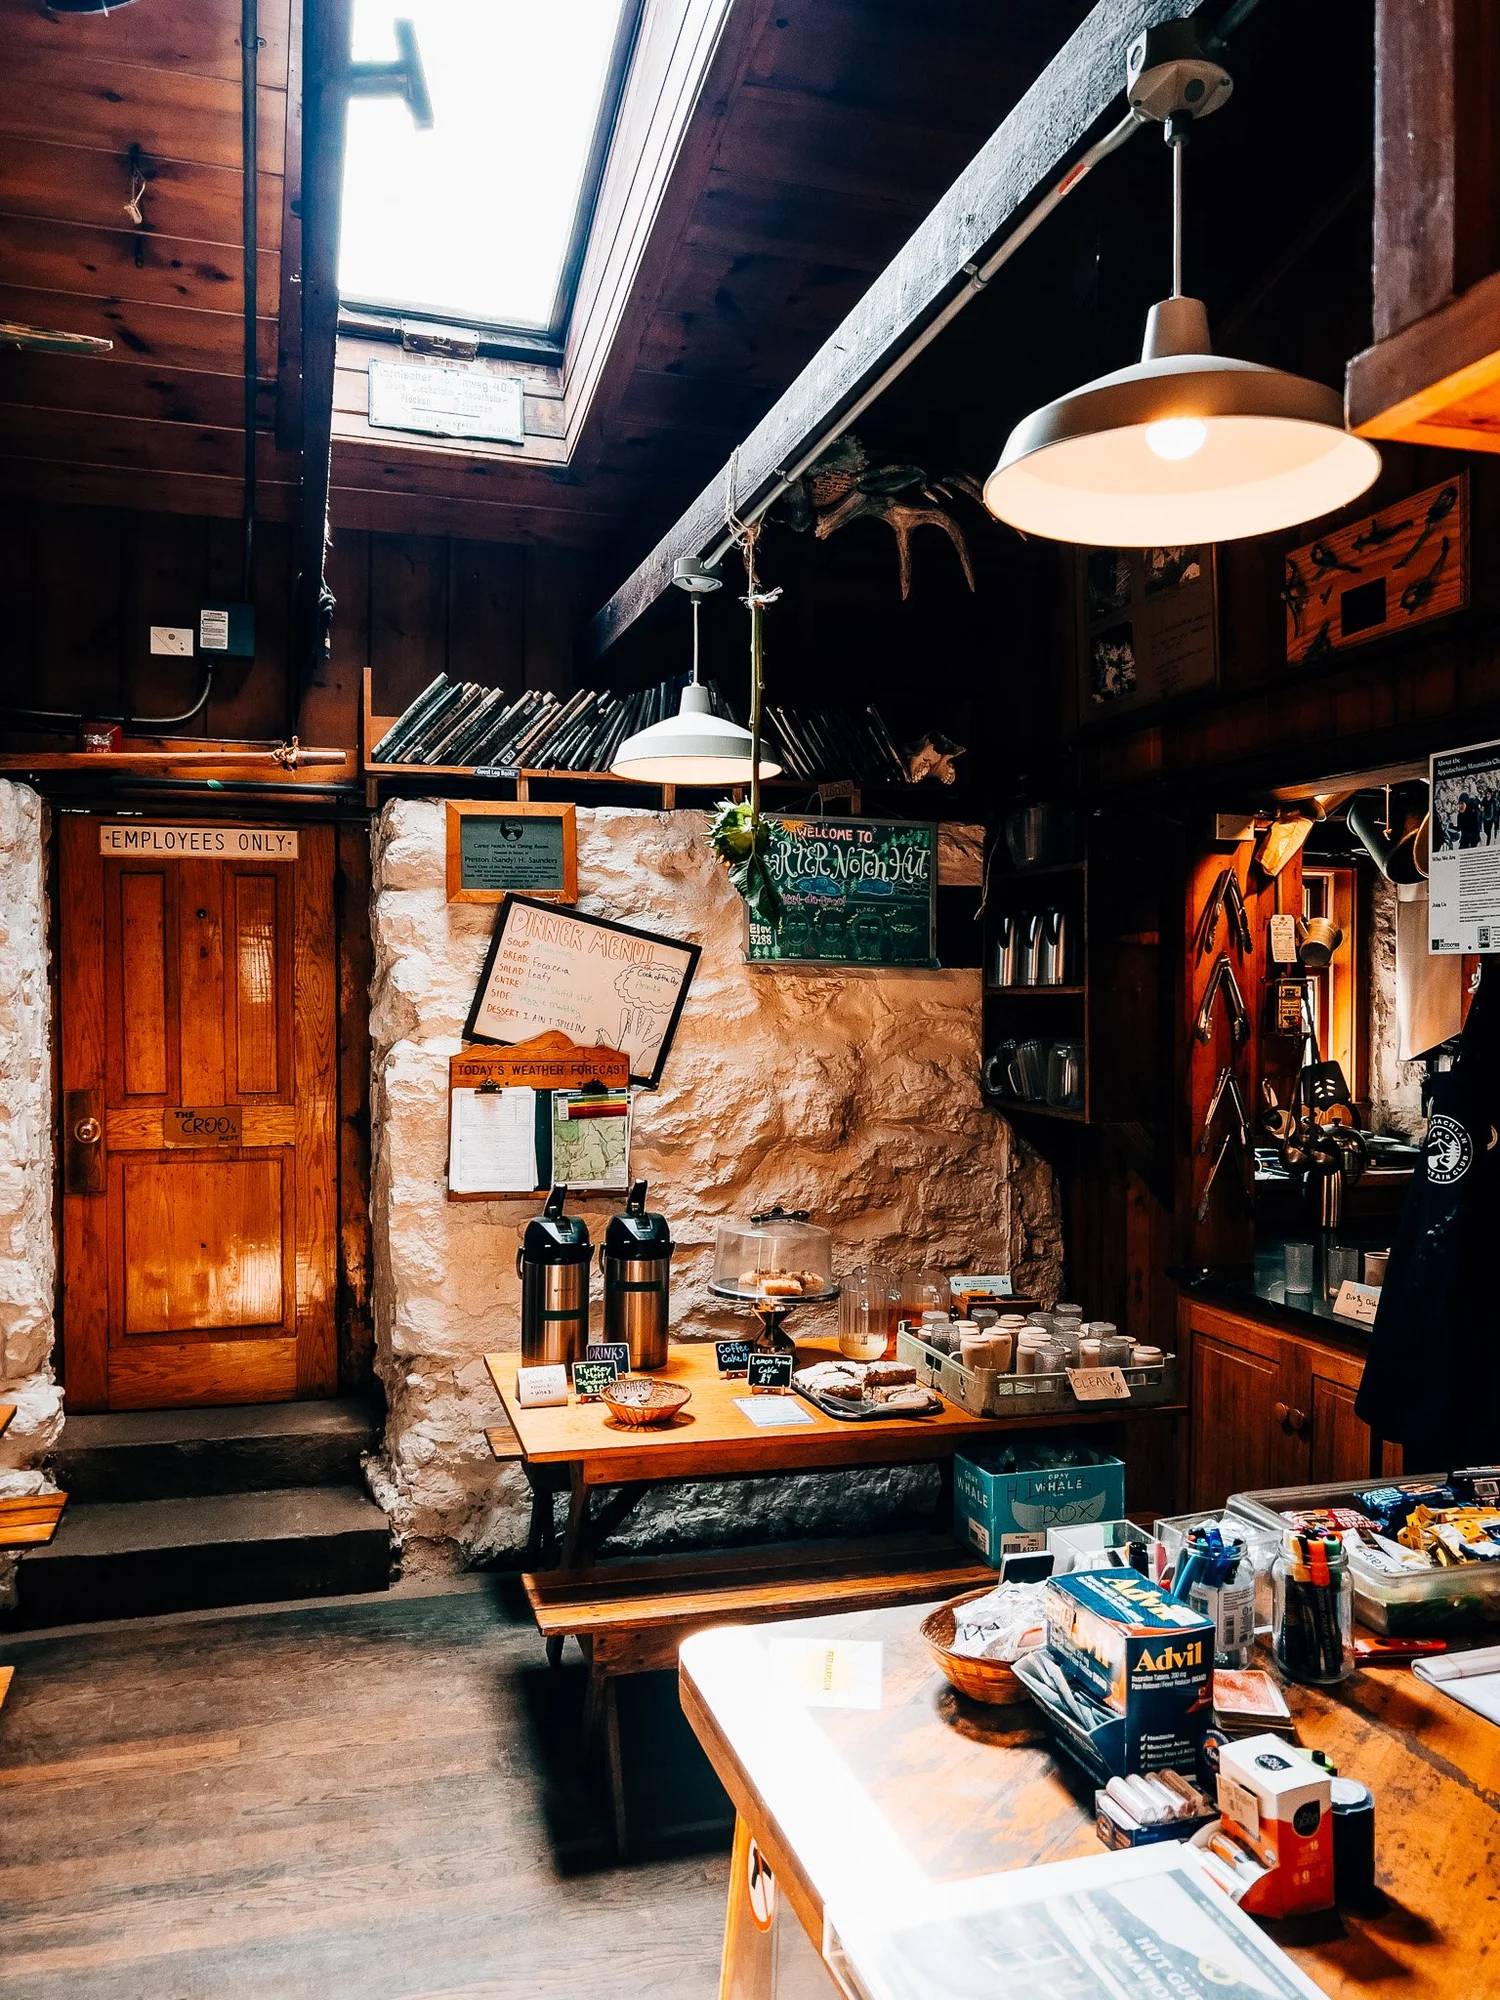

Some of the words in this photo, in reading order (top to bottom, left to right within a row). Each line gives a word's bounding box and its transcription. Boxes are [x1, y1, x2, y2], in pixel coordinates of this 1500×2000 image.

[86, 746, 109, 754] FIRE
[111, 830, 225, 851] EMPLOYEES
[238, 833, 286, 853] ONLY
[796, 826, 853, 842] WELCOME
[858, 829, 874, 845] TO
[465, 856, 490, 864] Preston
[492, 856, 517, 865] (Sandy)
[528, 857, 558, 865] Saunders
[511, 907, 585, 951] DINNER
[588, 931, 654, 964] MENU!
[750, 934, 772, 945] 3288
[502, 950, 530, 965] BREAD:
[458, 1064, 505, 1076] TODAY'S
[512, 1064, 564, 1076] WEATHER
[571, 1064, 627, 1076] FORECAST
[174, 1110, 195, 1119] THE
[218, 1134, 239, 1142] NEST
[1432, 1131, 1450, 1140] AMC
[1452, 1155, 1469, 1176] CLUB
[589, 1347, 625, 1360] DRINKS
[718, 1343, 750, 1354] Coffee
[722, 1354, 743, 1363] Cake
[752, 1356, 773, 1365] Lemon
[575, 1364, 611, 1376] Turkey
[758, 1366, 779, 1374] Cake
[613, 1383, 627, 1394] PAY
[630, 1381, 650, 1393] HERE
[964, 1470, 978, 1484] GRAY
[1048, 1472, 1069, 1481] GRAY
[957, 1475, 988, 1509] WHALE
[1035, 1479, 1082, 1493] WHALE
[1043, 1502, 1095, 1525] BOX
[1132, 1641, 1203, 1672] Advil
[1131, 1682, 1142, 1690] Pain
[1135, 1936, 1168, 1970] HUT
